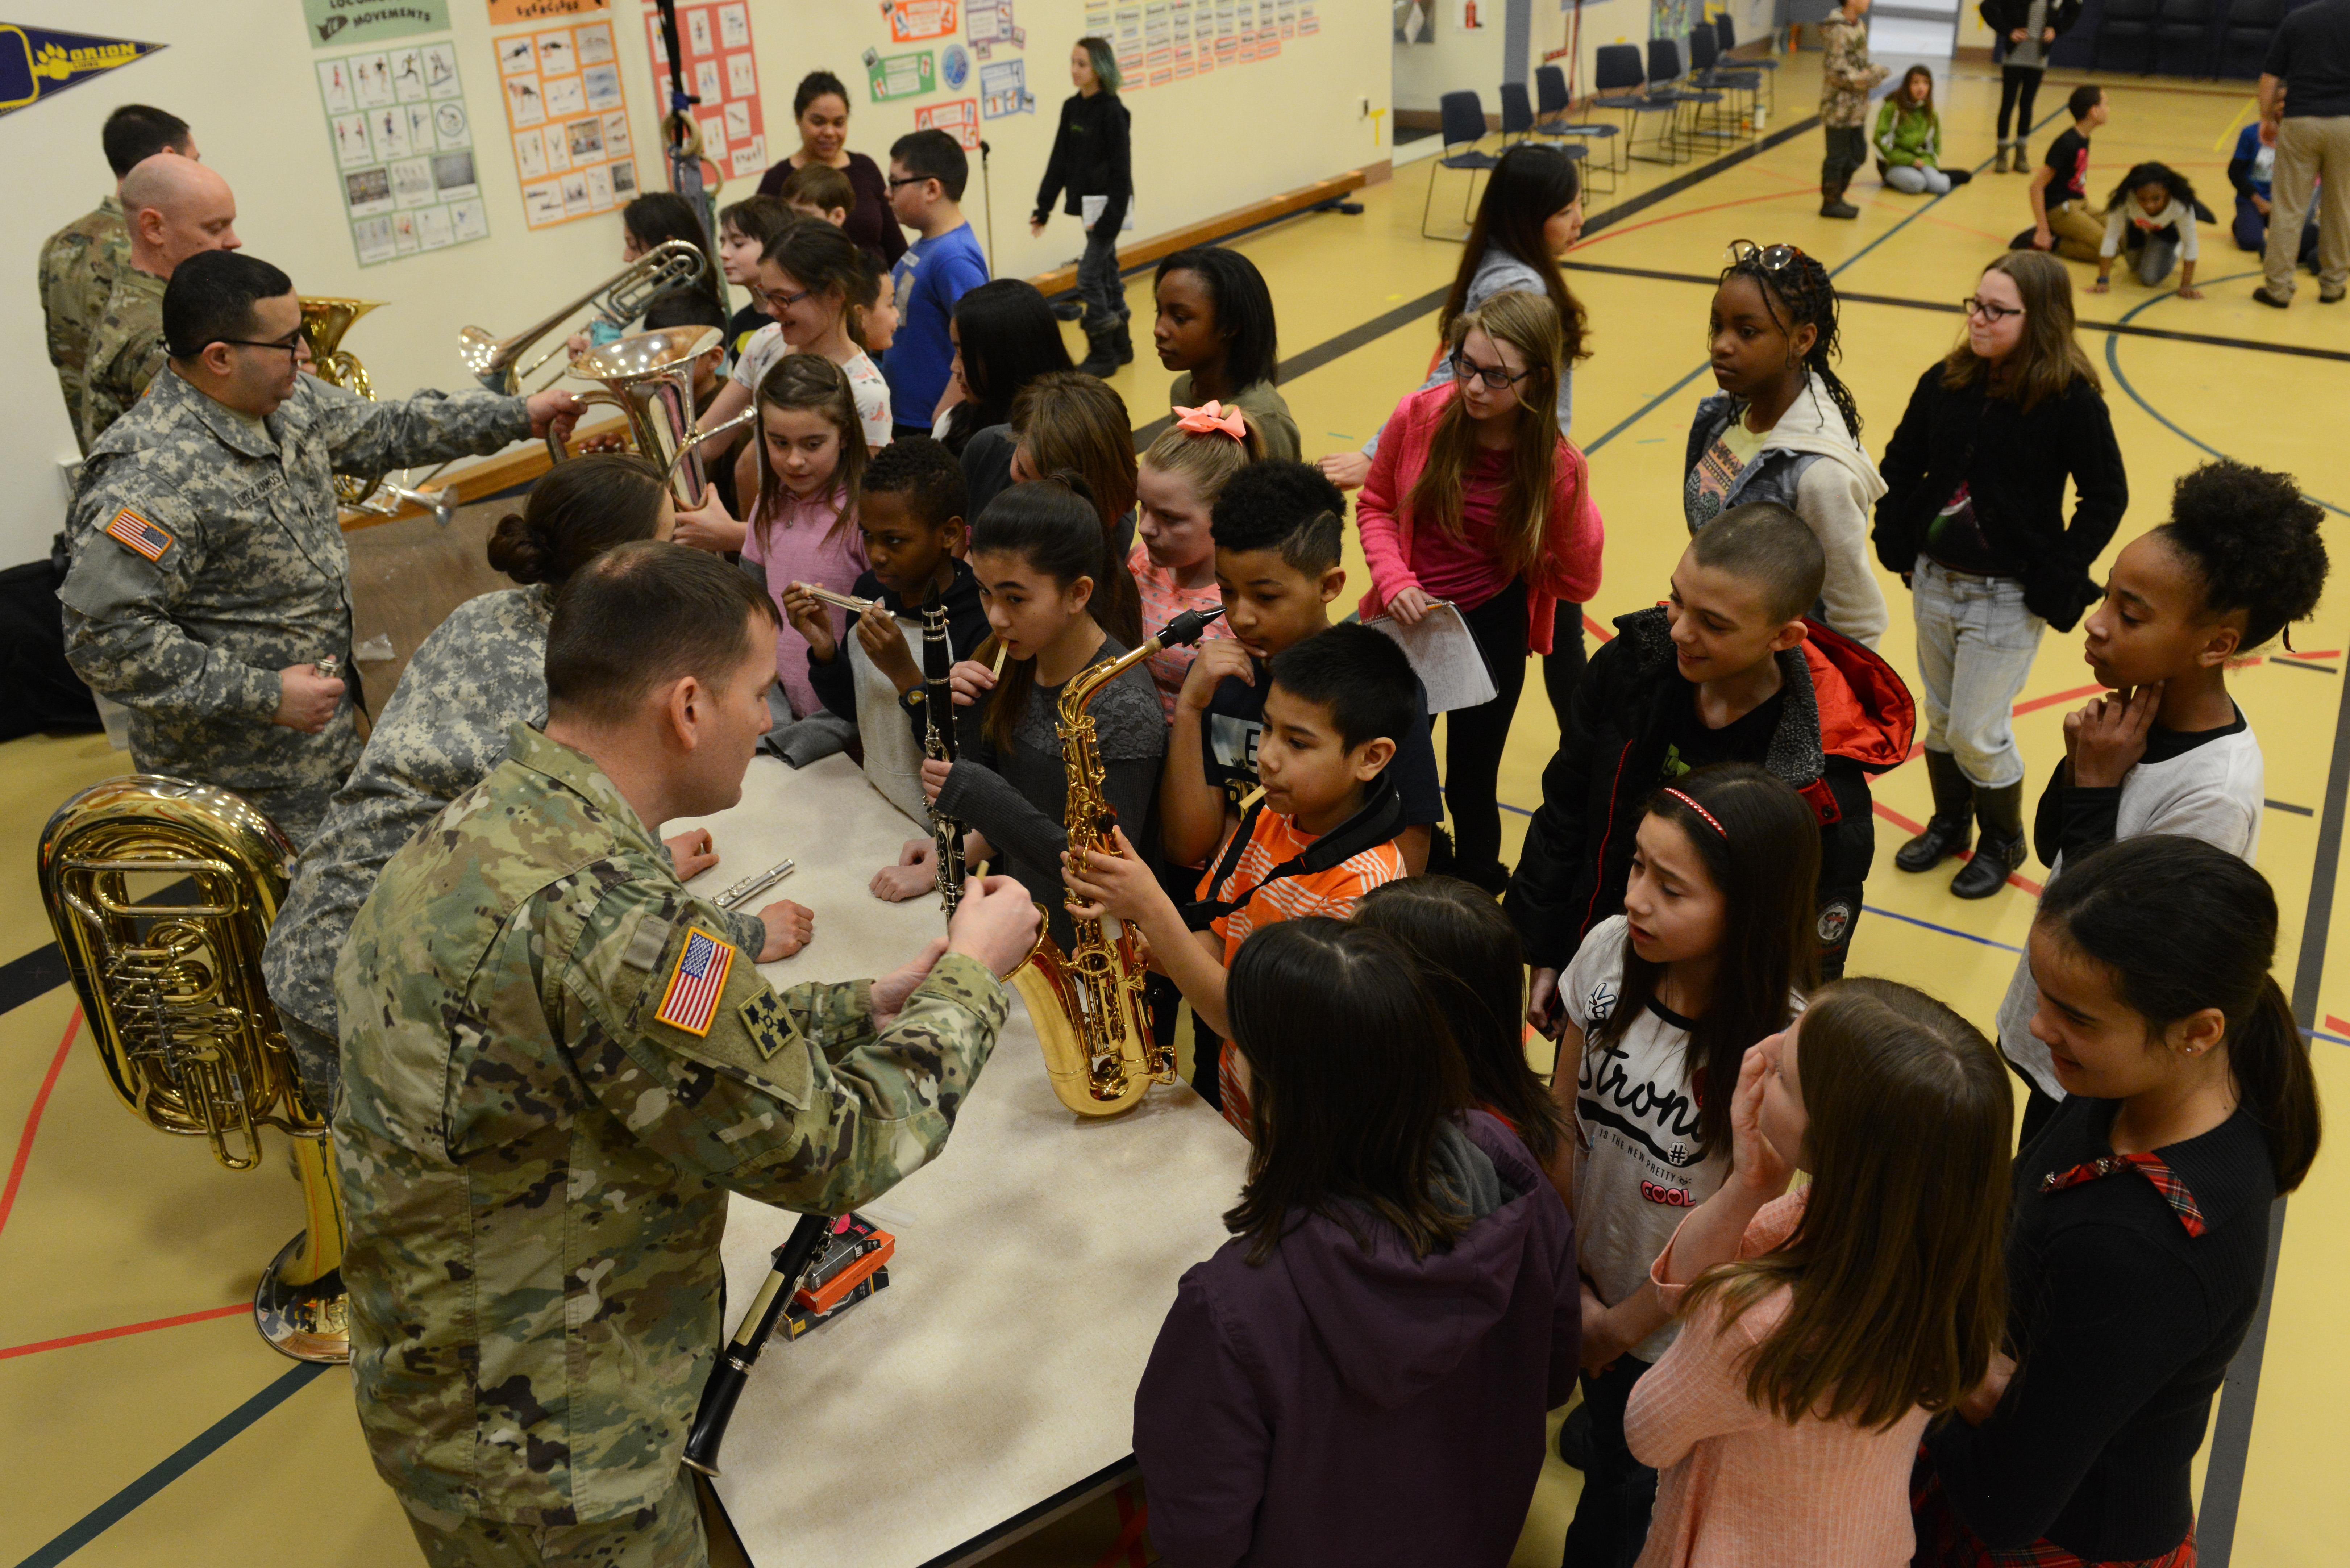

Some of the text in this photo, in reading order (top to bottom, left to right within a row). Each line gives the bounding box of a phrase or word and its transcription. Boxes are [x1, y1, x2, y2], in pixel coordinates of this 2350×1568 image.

[353, 7, 431, 27] MOVEMENTS
[70, 42, 136, 60] ORION
[1578, 1020, 1702, 1143] Stron
[1600, 1129, 1677, 1182] IS THE NEW PRETTY
[1640, 1180, 1696, 1207] COOL
